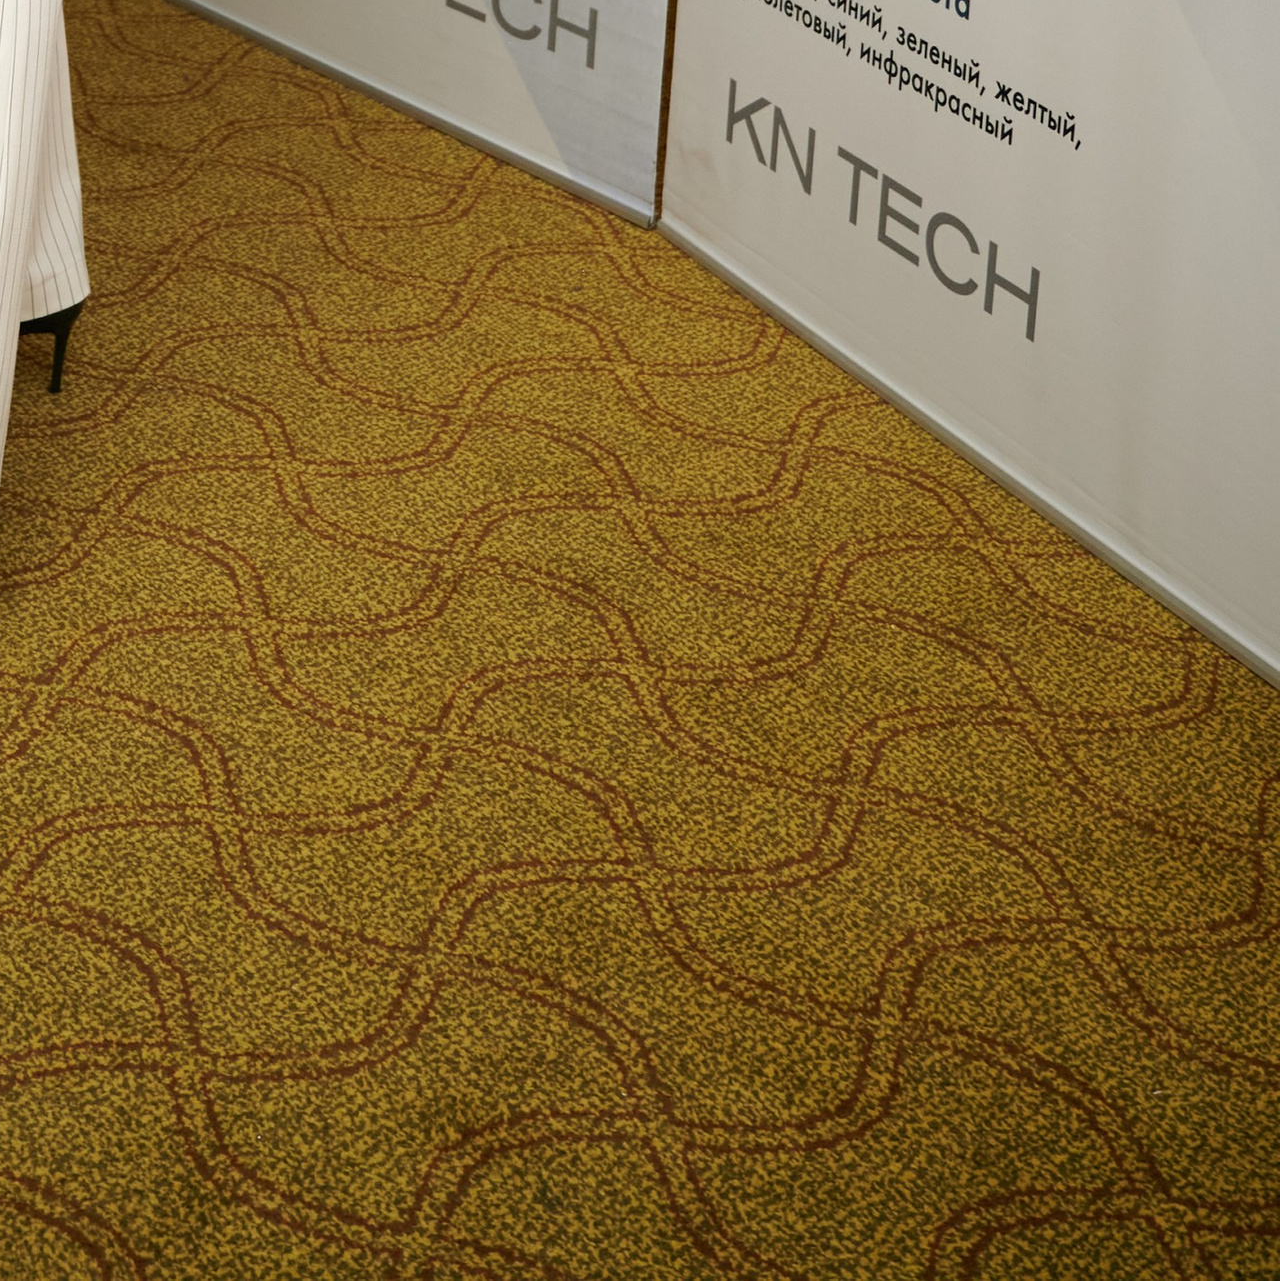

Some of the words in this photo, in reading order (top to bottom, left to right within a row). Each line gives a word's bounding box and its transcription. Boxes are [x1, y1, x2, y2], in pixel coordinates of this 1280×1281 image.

[860, 42, 1013, 146] инфракрасный
[896, 25, 986, 96] зеленый,
[995, 80, 1082, 151] желтый,
[725, 77, 816, 196] KN
[837, 145, 1041, 343] TECH
